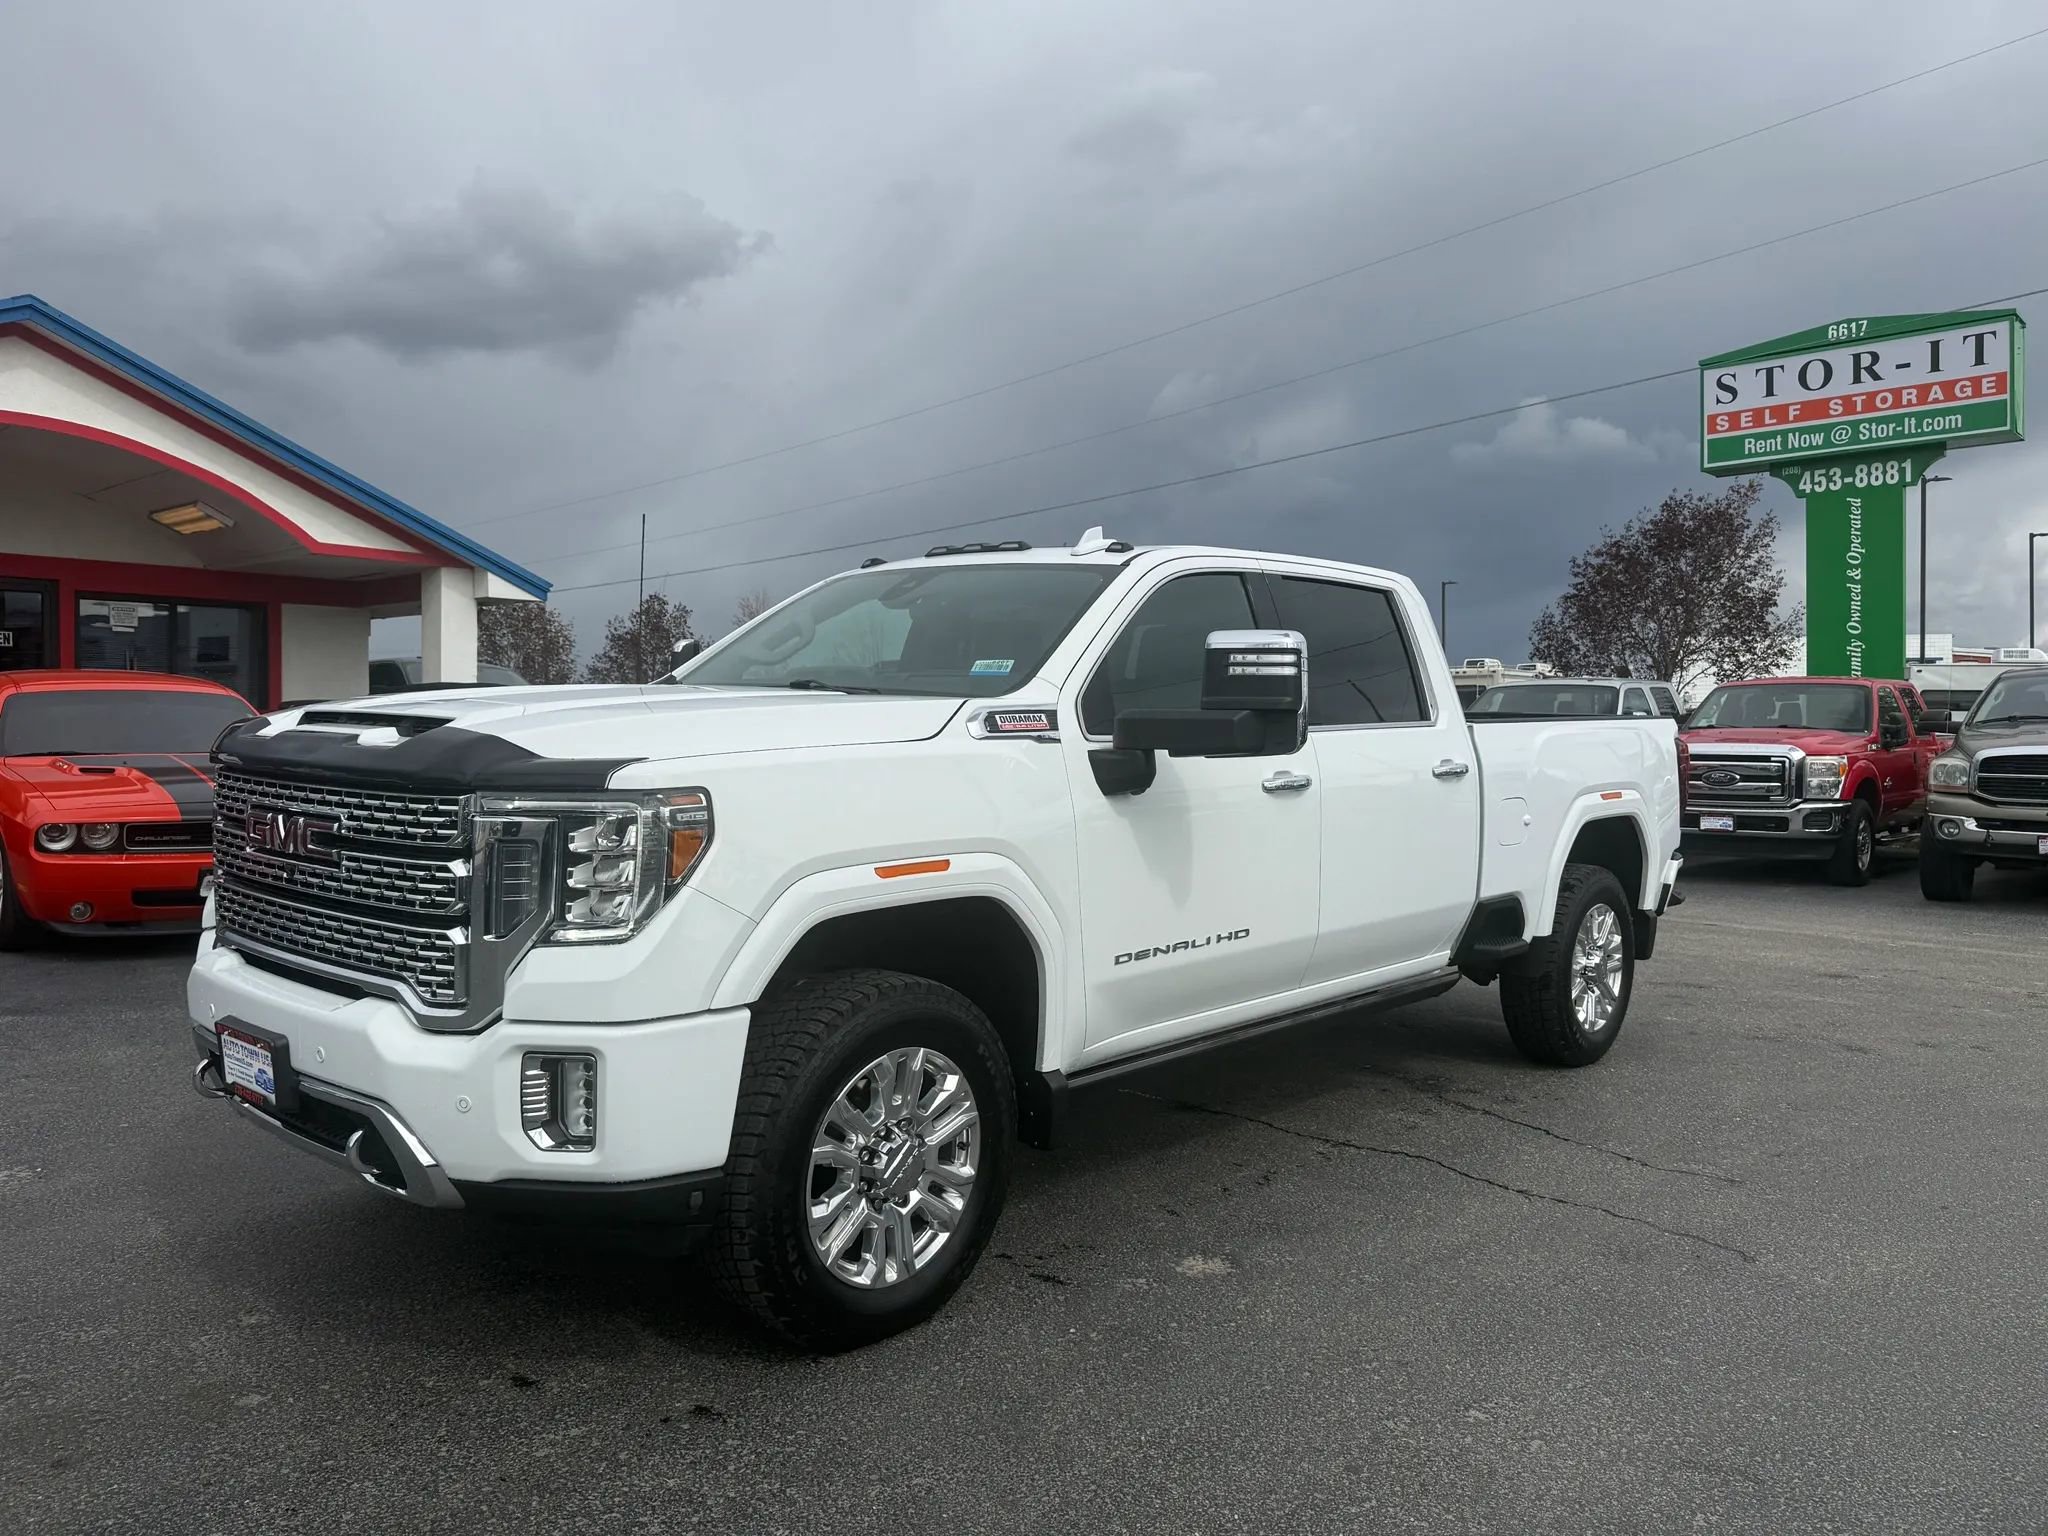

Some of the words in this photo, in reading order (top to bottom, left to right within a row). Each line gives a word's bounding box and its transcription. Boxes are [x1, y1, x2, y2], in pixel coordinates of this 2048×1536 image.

[1828, 320, 1867, 341] 6617
[1716, 330, 1997, 406] STOR-IT
[1716, 405, 1801, 431] SELF
[1829, 376, 1997, 415] STORAGE
[1744, 435, 1782, 454] Rent
[1788, 432, 1824, 449] Now
[1831, 425, 1852, 444] @
[1859, 414, 1962, 440] Stor-It.com
[1799, 458, 1912, 493] 453-8881
[1846, 498, 1866, 564] Operated
[1846, 567, 1862, 580] &
[1846, 584, 1862, 634] Owned
[1847, 639, 1865, 678] amily
[999, 714, 1045, 724] DURAMAX
[246, 812, 340, 862] GMC
[1114, 936, 1211, 966] DENALI
[1216, 928, 1250, 944] HD
